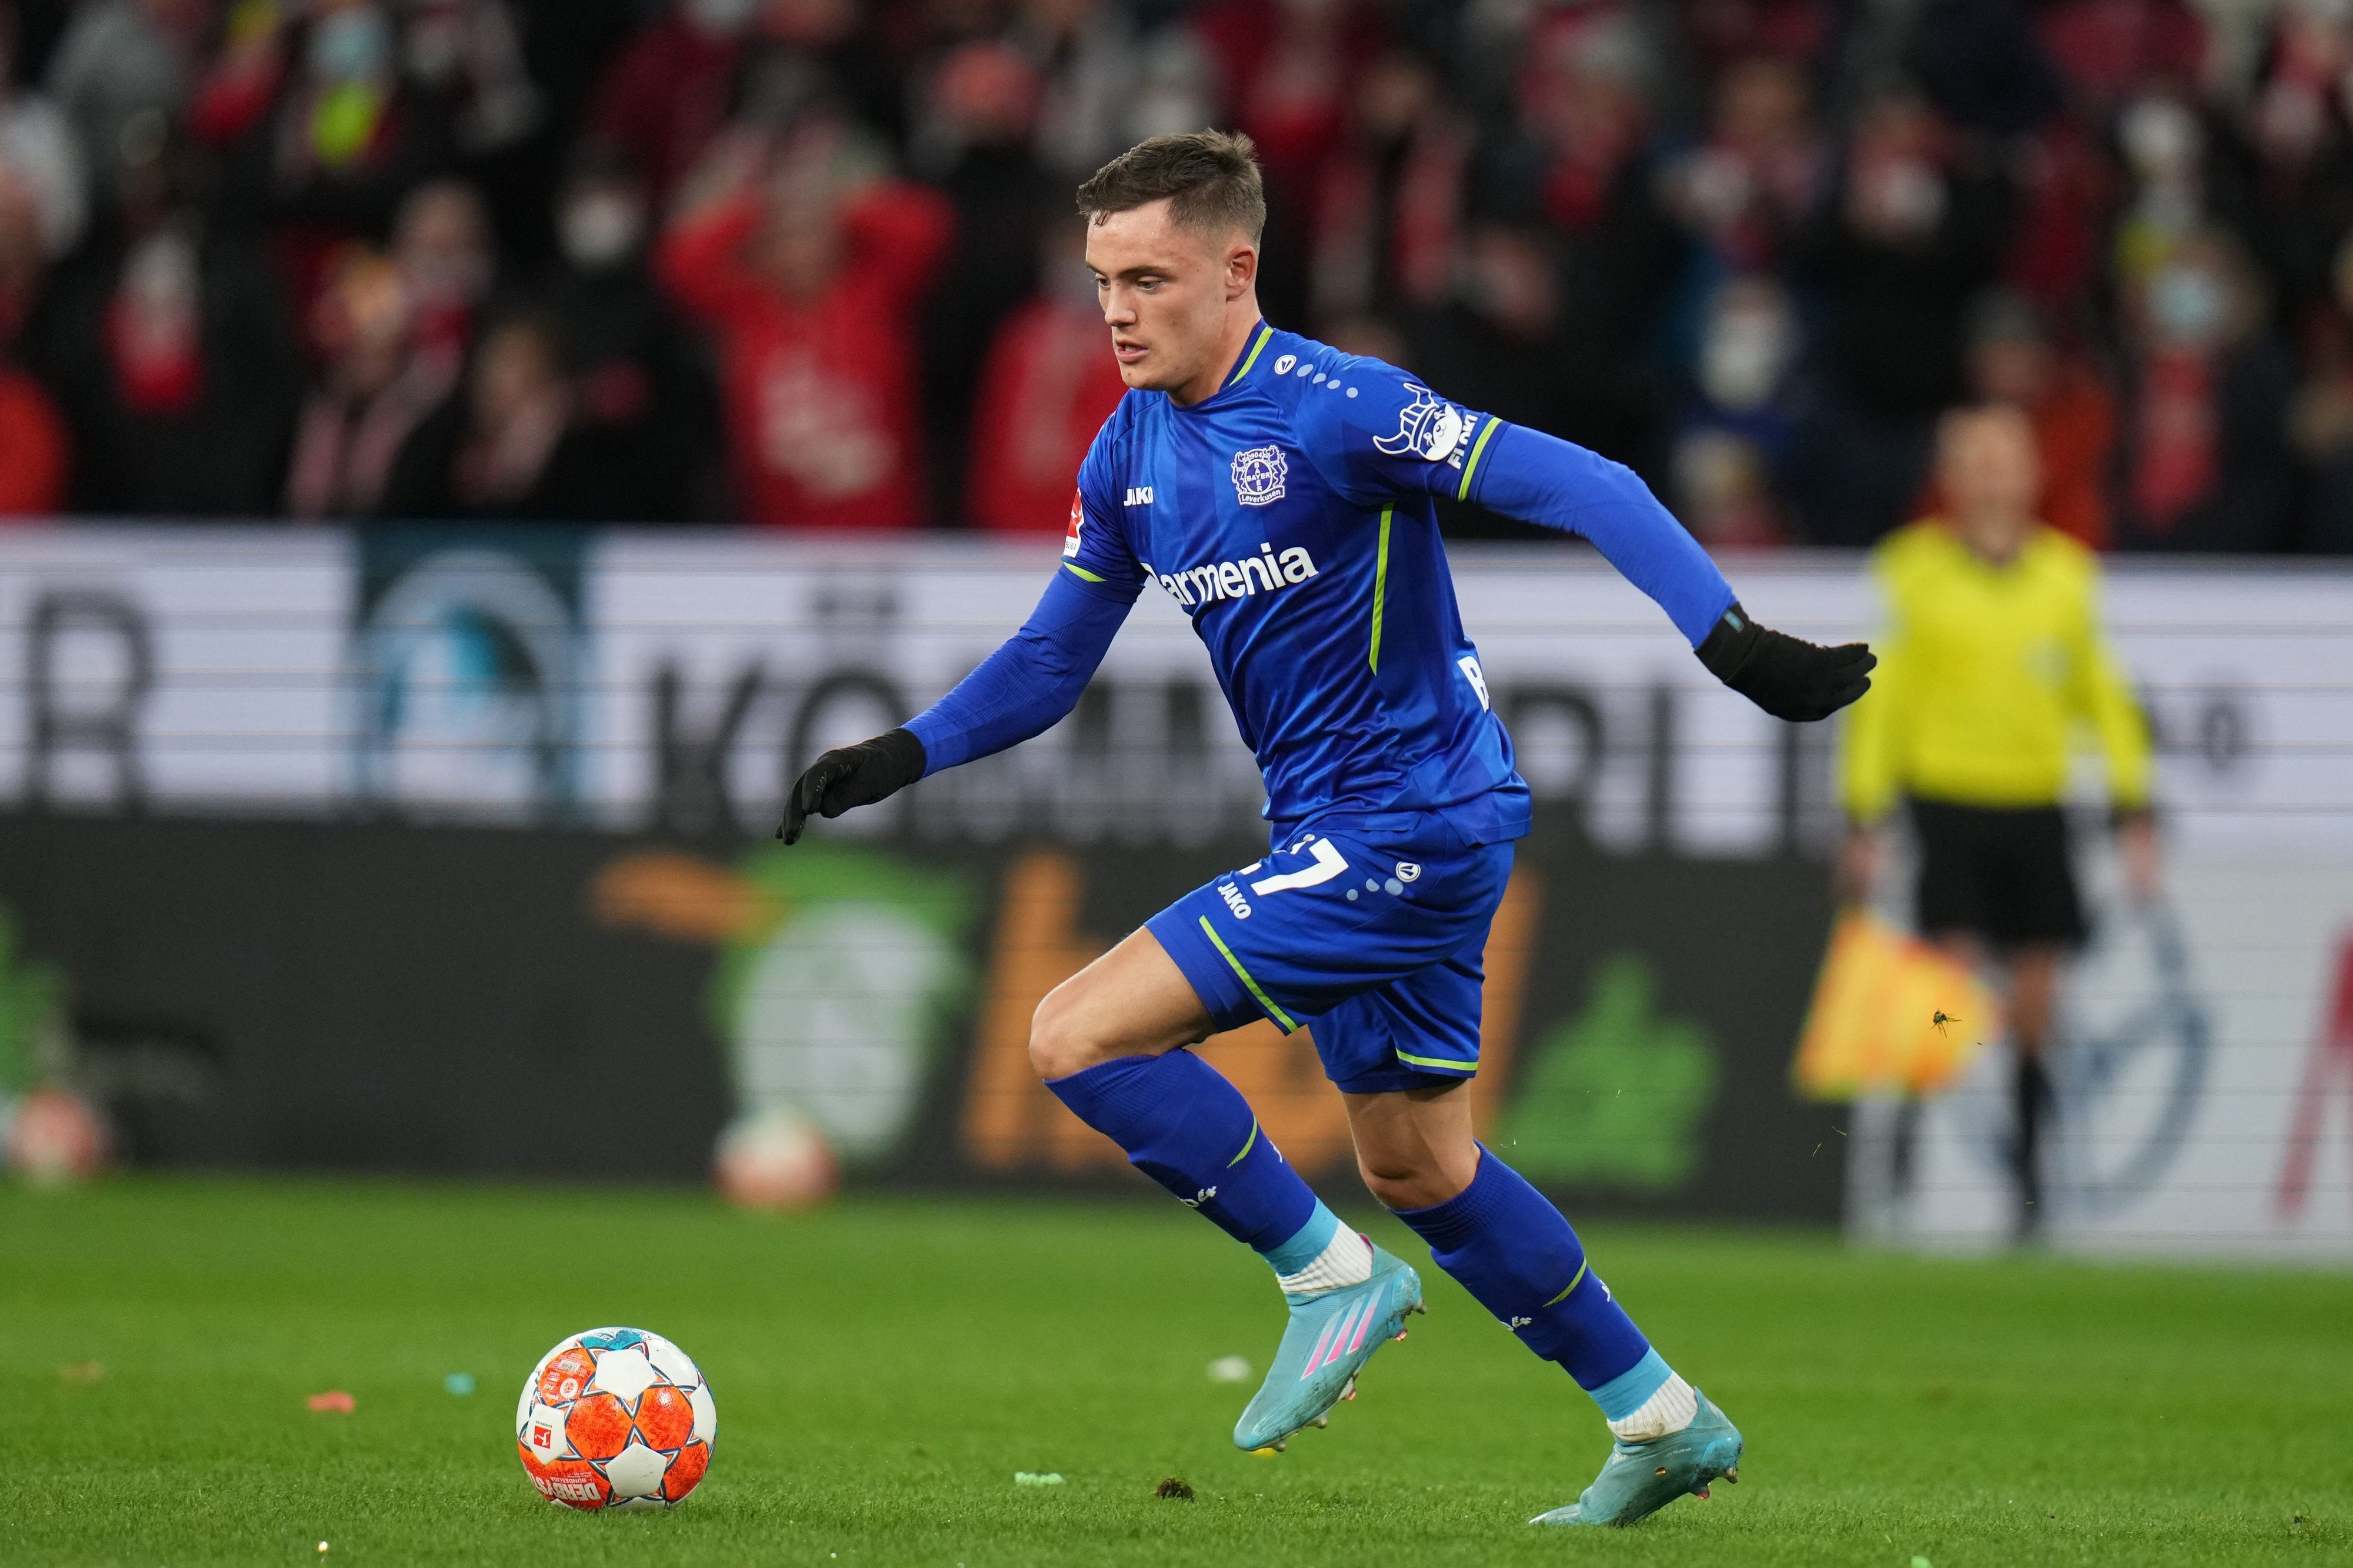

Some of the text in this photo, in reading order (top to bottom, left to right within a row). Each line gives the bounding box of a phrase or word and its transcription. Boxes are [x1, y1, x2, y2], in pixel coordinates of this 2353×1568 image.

[1247, 472, 1271, 482] BAYER
[1241, 489, 1281, 503] Leverkusen
[1217, 882, 1252, 919] JAKO
